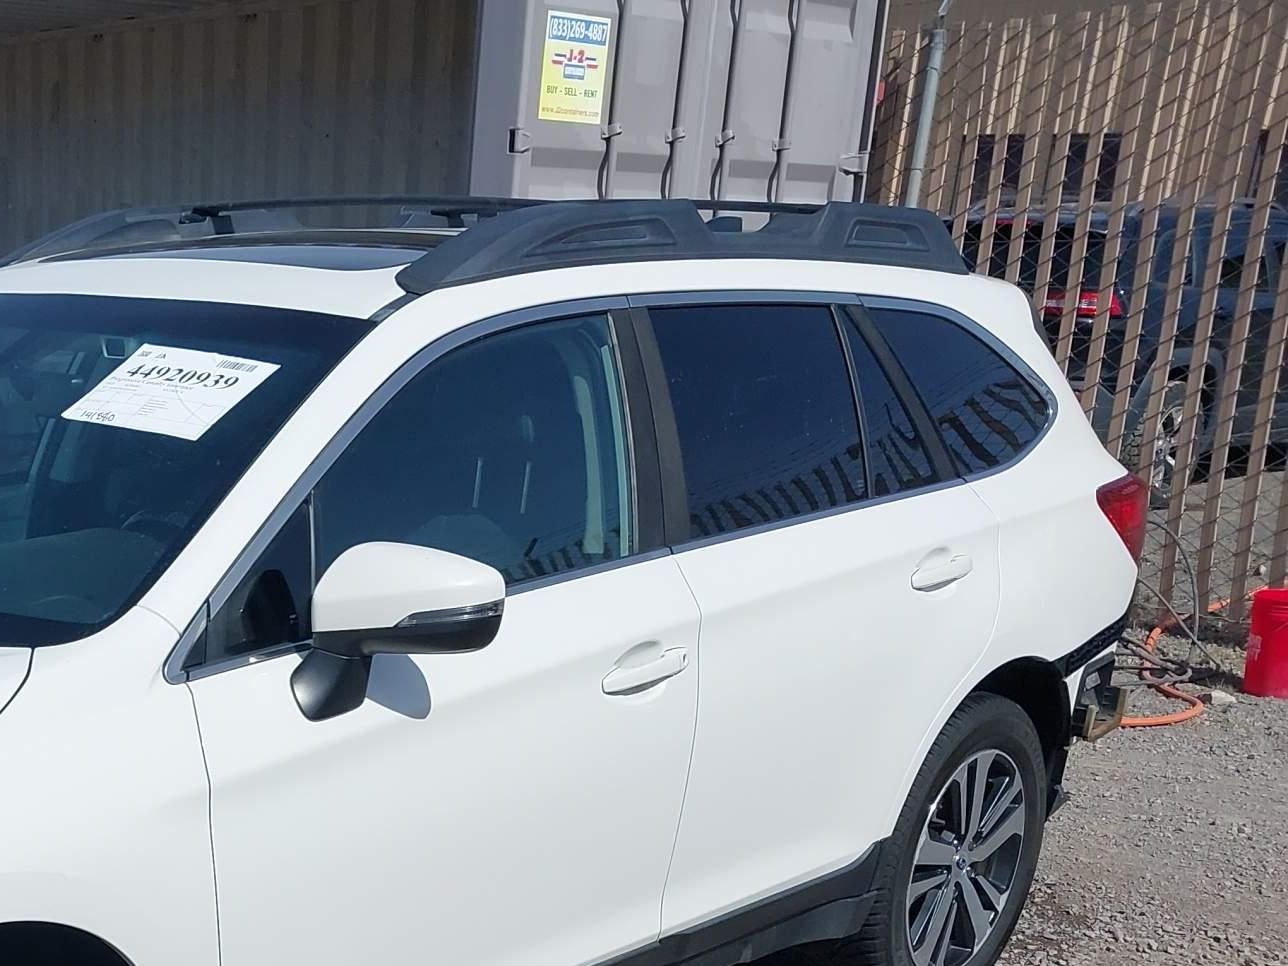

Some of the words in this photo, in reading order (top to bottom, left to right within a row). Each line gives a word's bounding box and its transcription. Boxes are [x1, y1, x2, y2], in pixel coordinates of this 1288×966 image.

[549, 17, 608, 42] (833)269-4887
[546, 85, 558, 94] BUY
[564, 87, 578, 97] SELL
[583, 89, 598, 98] RENT
[126, 363, 240, 390] 44920939
